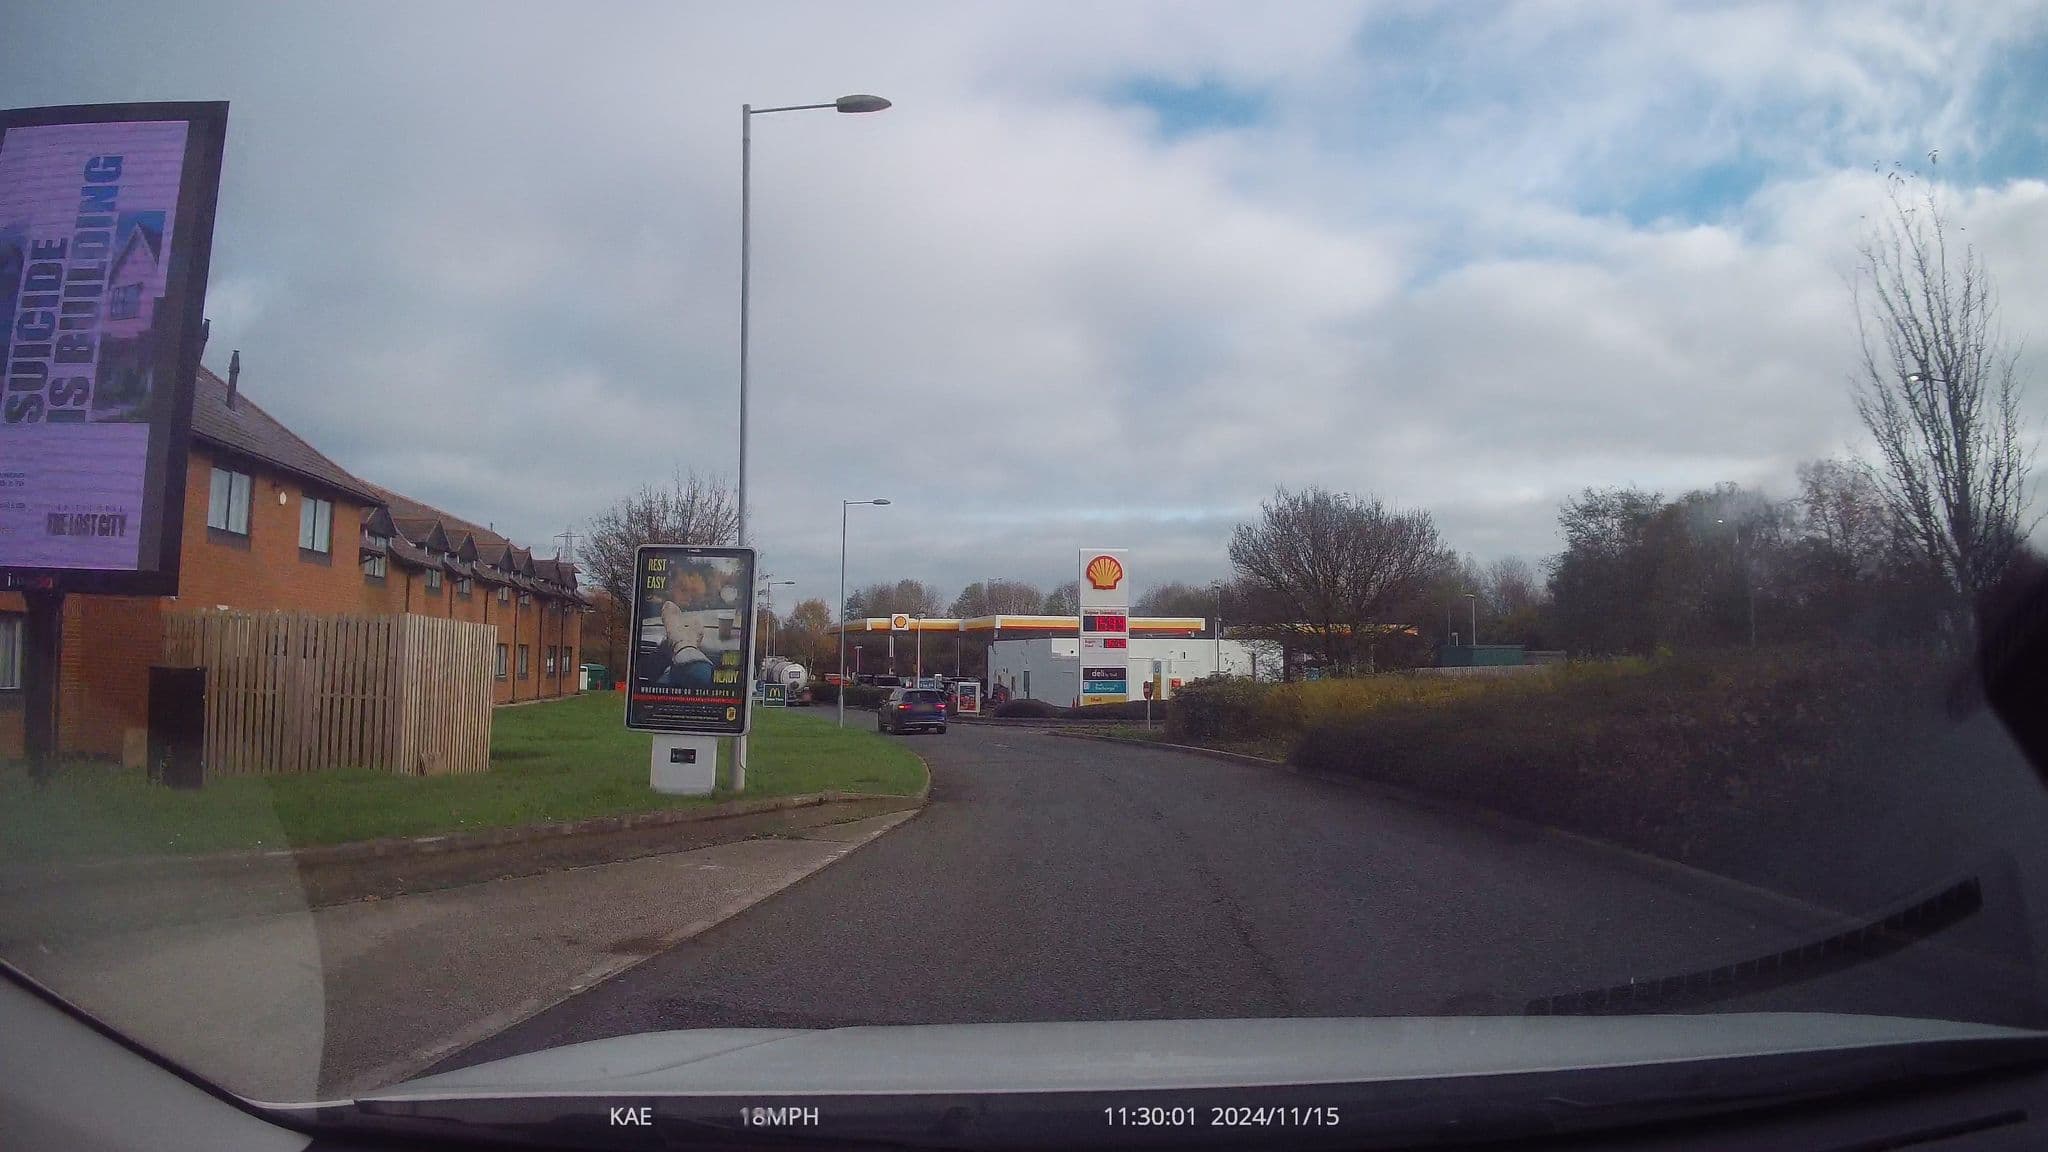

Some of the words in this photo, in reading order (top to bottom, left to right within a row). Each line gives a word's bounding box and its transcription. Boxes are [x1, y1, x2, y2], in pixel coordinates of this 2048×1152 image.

[53, 155, 124, 364] BUILDING
[4, 236, 69, 424] SUICIDE
[46, 376, 90, 424] IS
[646, 576, 666, 589] EASY
[648, 558, 667, 571] REST
